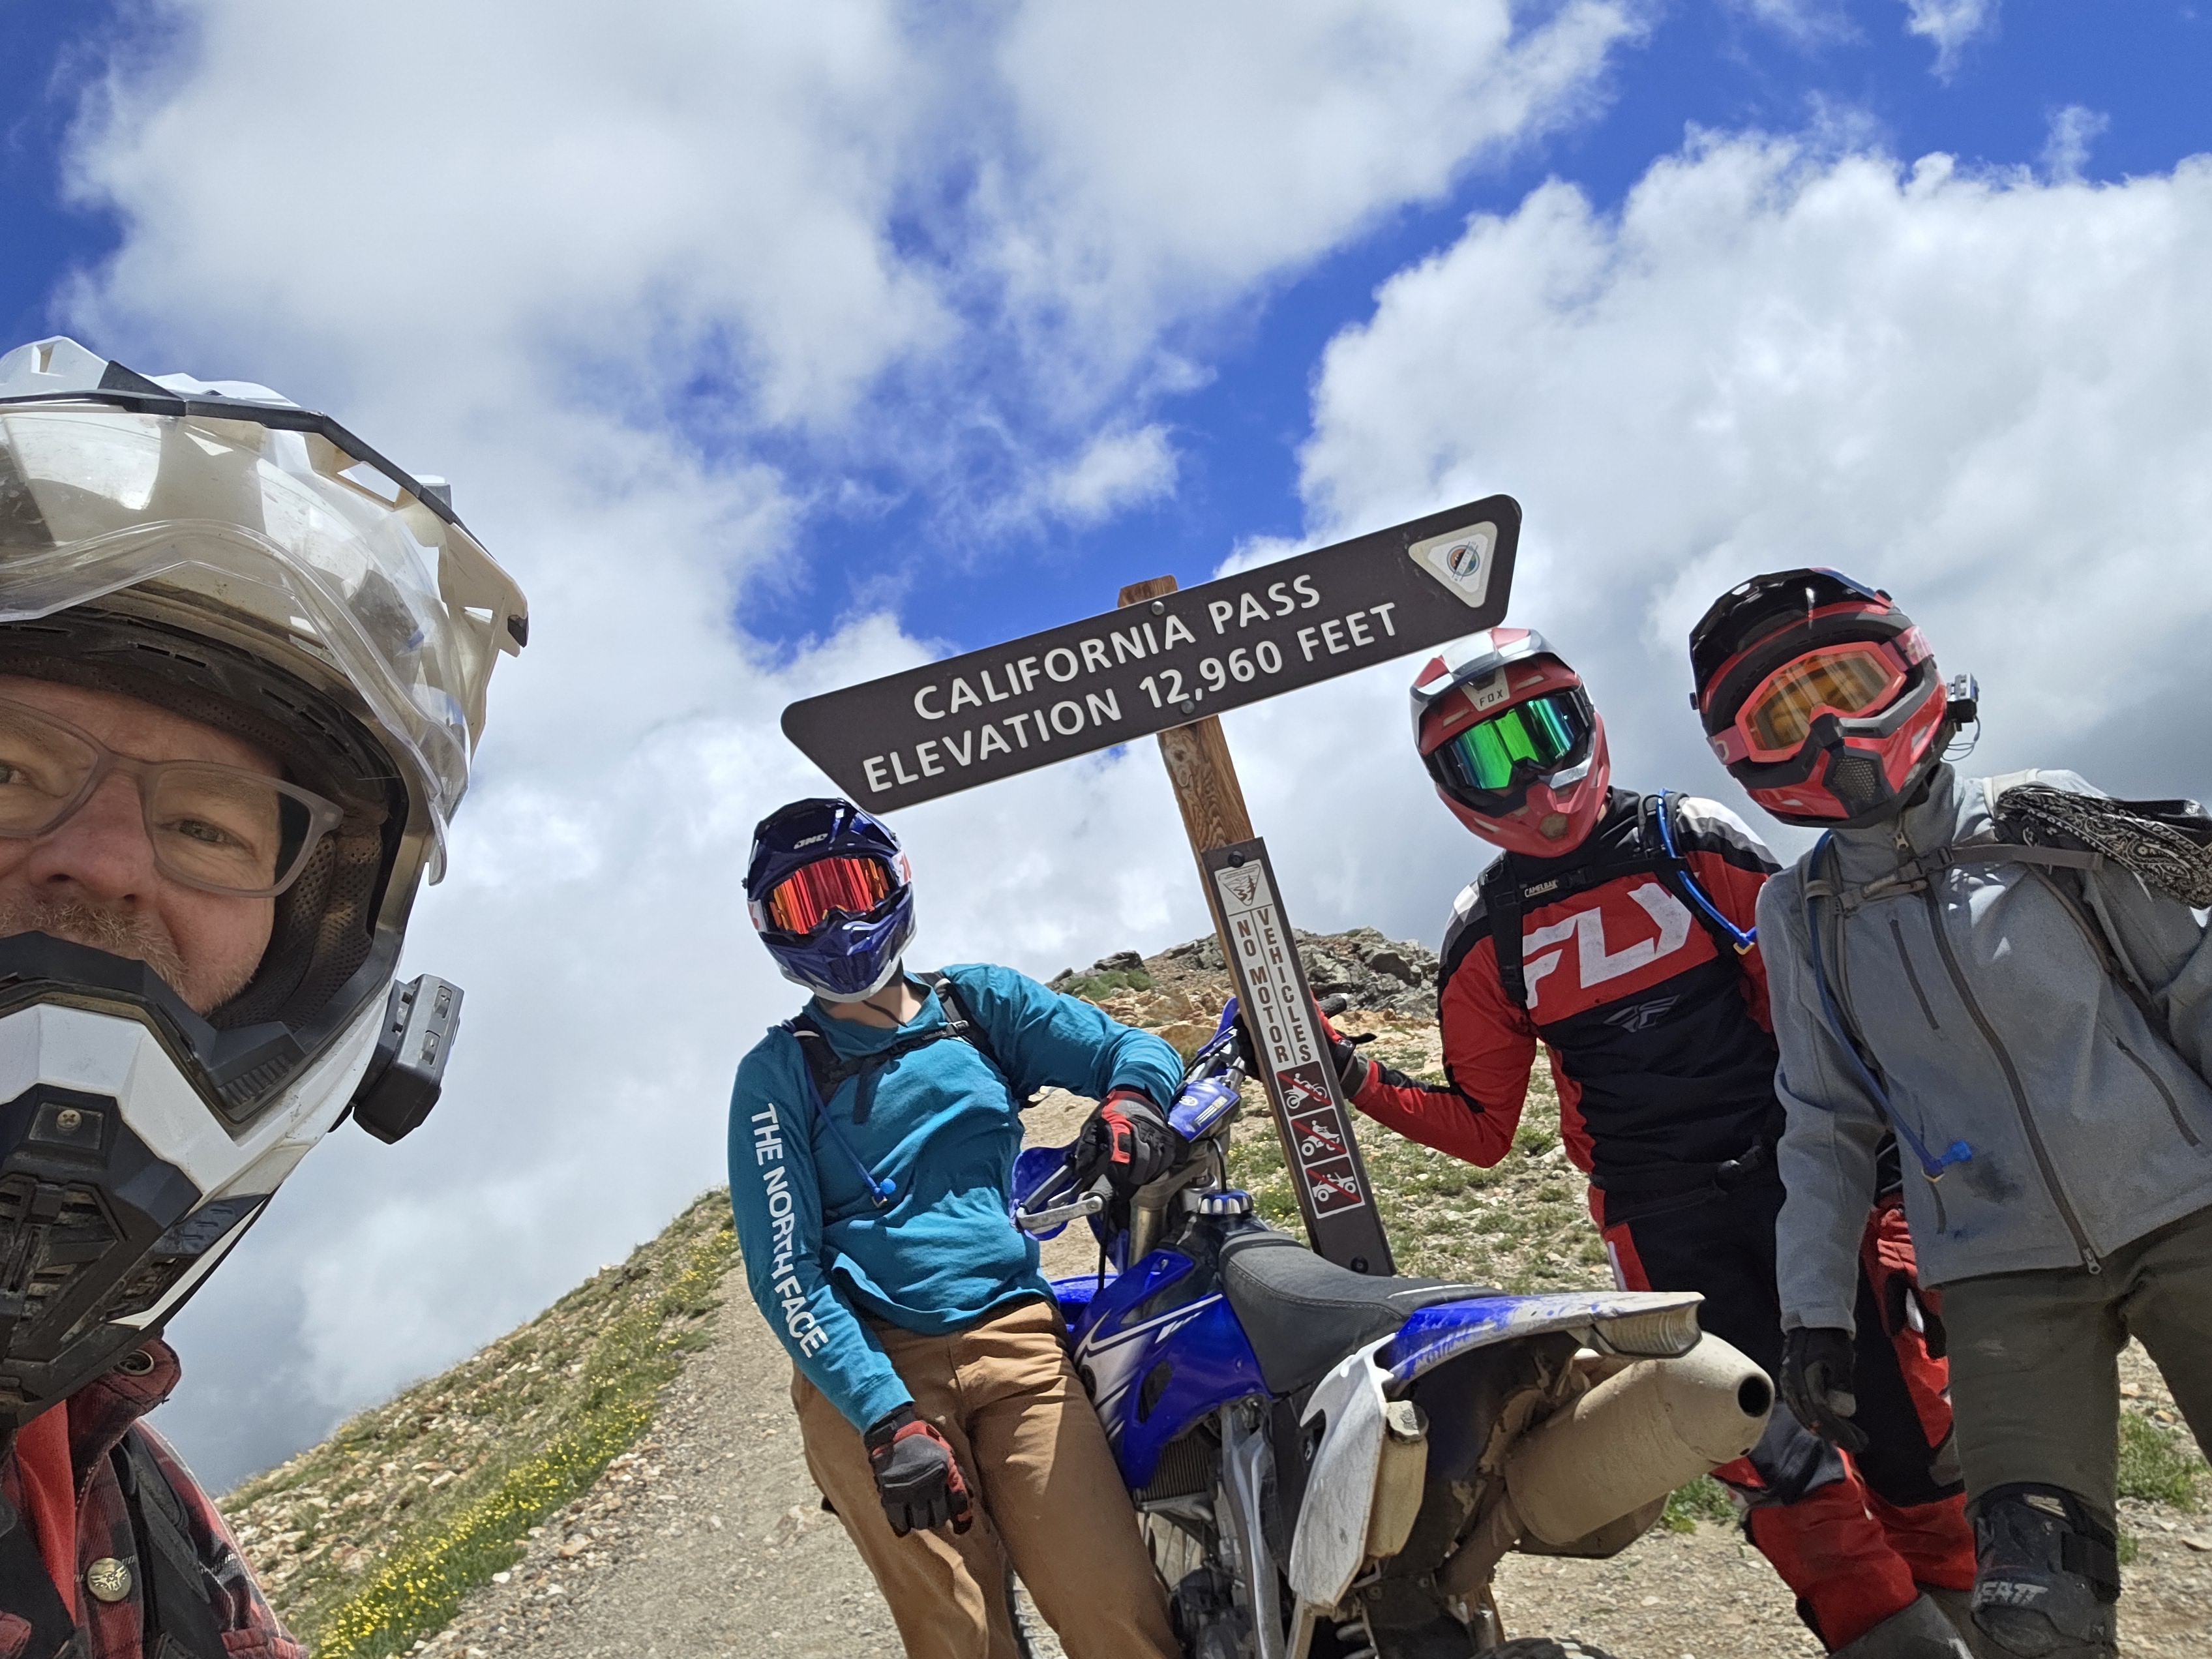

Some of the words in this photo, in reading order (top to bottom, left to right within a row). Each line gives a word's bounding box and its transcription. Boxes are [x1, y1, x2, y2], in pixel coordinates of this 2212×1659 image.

[863, 688, 1122, 792] ELEVATION
[1139, 640, 1282, 708] 12,960
[1296, 602, 1396, 662] FEET
[914, 614, 1196, 720] CALIFORNIA
[1208, 575, 1320, 635] PASS
[1480, 689, 1503, 707] FOX
[1236, 919, 1257, 957] NO
[1248, 966, 1290, 1064] MOTOR
[1257, 908, 1312, 1062] VEHICLES
[1523, 882, 1692, 1010] FLY
[751, 1103, 783, 1166] THE
[762, 1166, 795, 1280] NORTH
[774, 1275, 829, 1358] FACE
